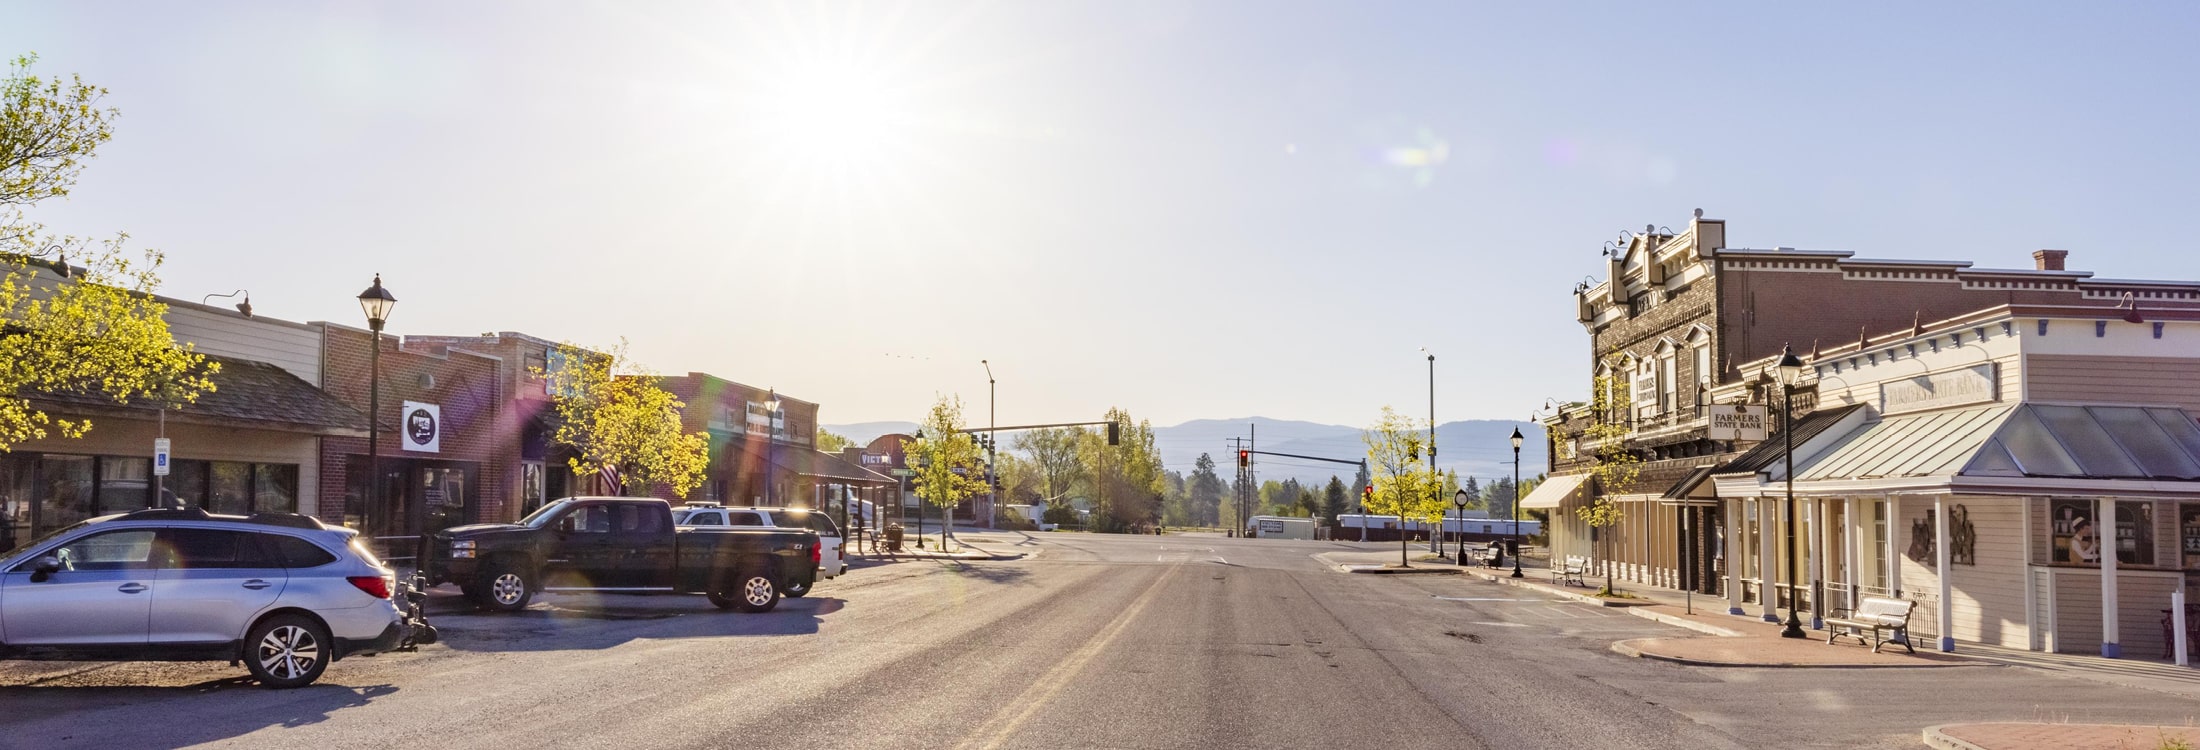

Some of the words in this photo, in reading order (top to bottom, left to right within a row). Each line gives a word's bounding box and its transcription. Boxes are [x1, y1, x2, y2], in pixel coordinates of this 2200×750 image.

[1889, 384, 1927, 406] FARMERS
[1956, 374, 1984, 396] BANK
[1715, 414, 1760, 423] FARMERS
[1740, 422, 1762, 430] BANK
[861, 454, 892, 465] VICTR
